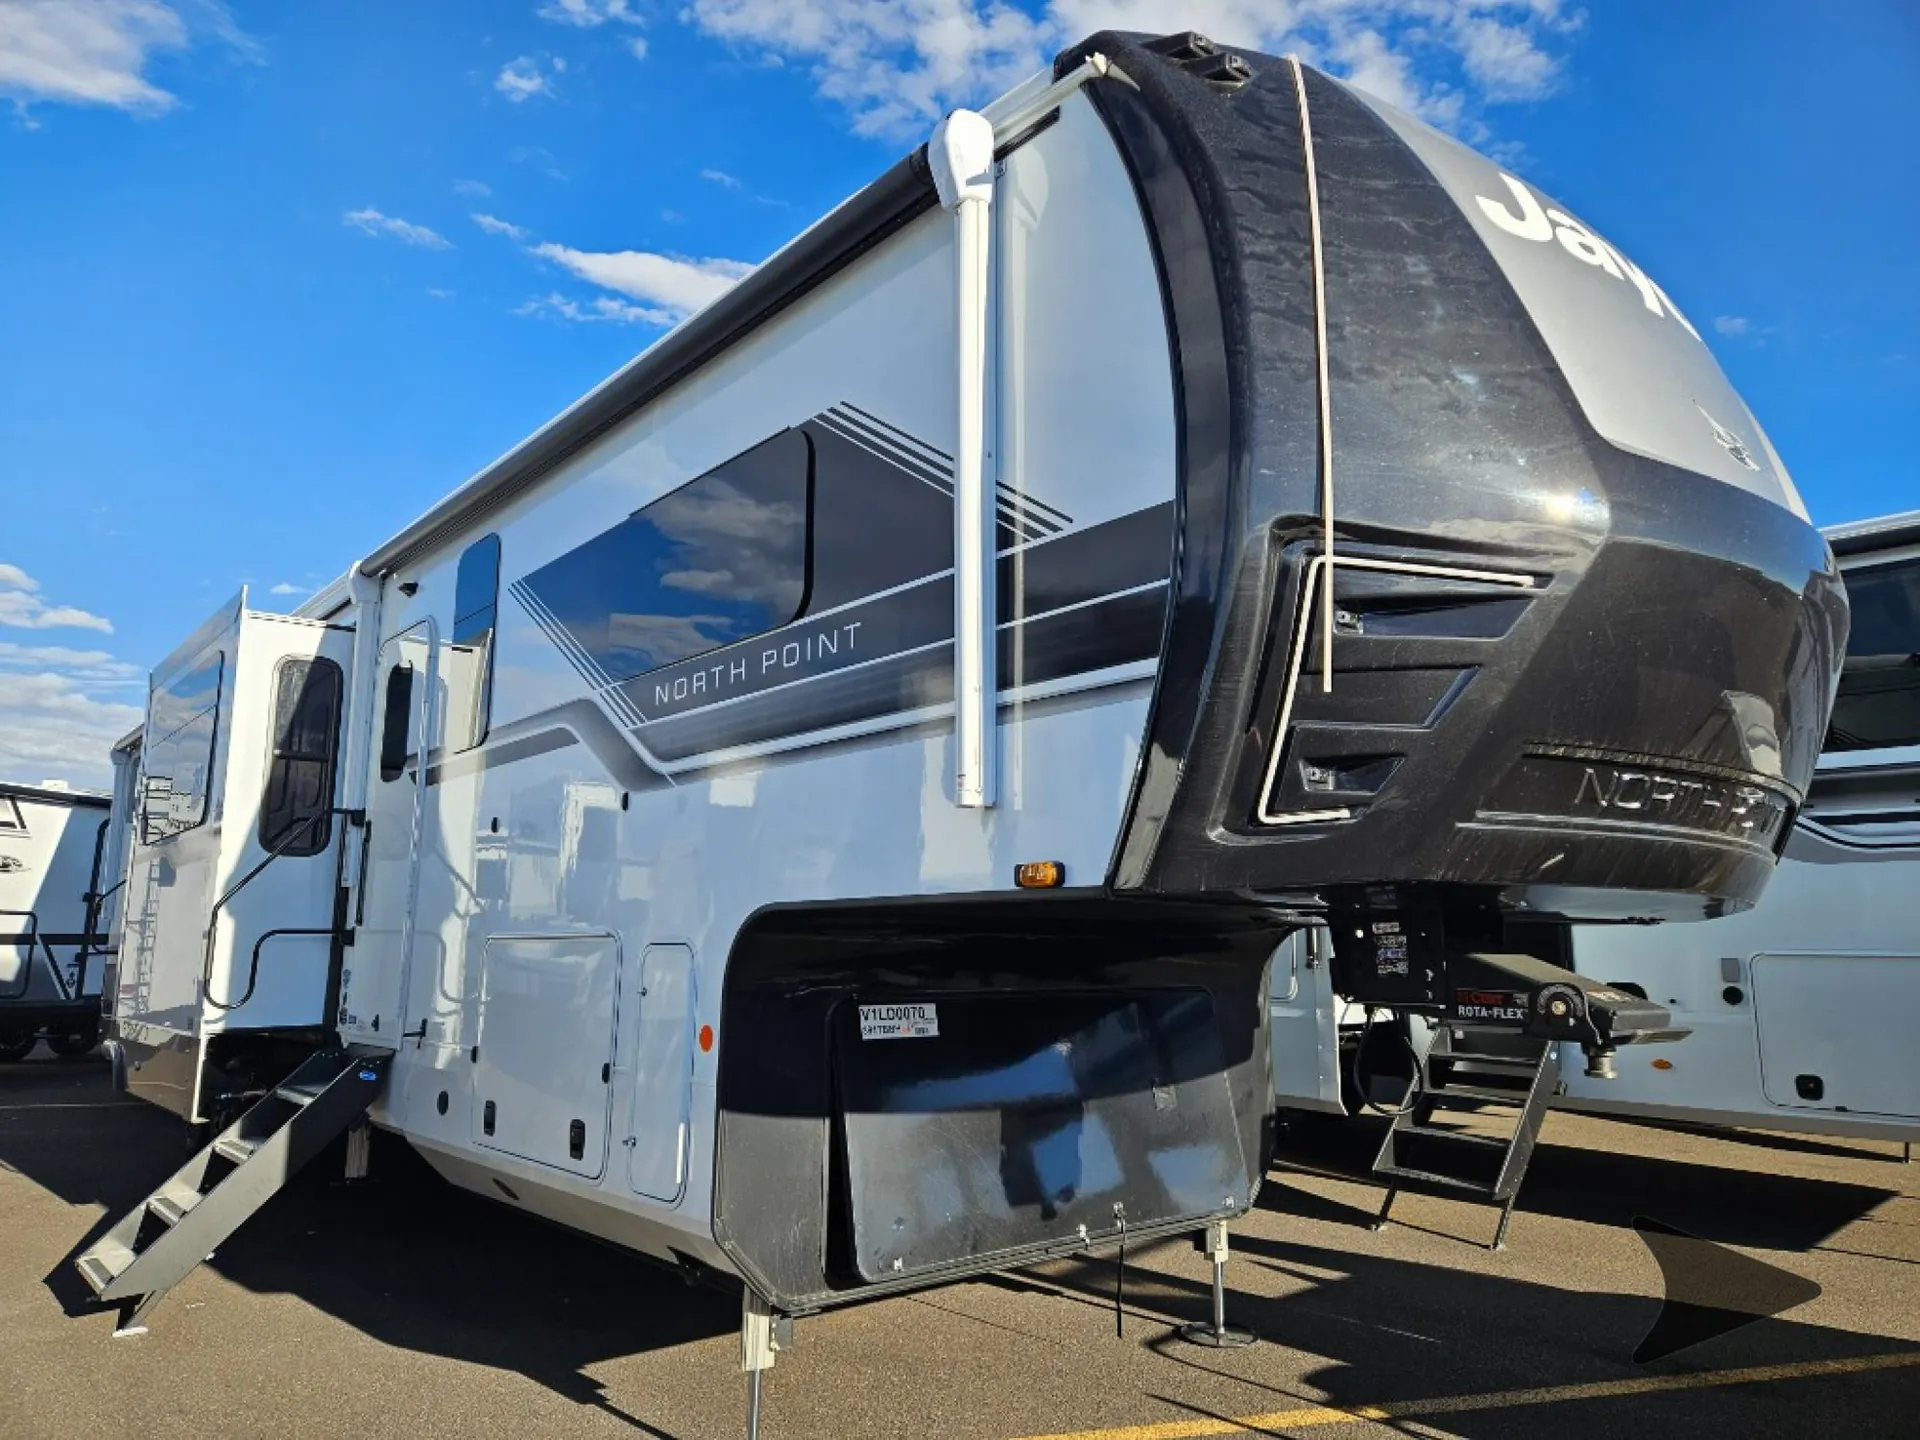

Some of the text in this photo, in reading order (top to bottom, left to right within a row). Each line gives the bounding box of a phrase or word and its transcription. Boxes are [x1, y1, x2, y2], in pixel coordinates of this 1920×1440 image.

[1475, 171, 1702, 342] Jay
[654, 621, 862, 706] NORTH POINT
[1458, 1004, 1524, 1019] ROTA-FLEX
